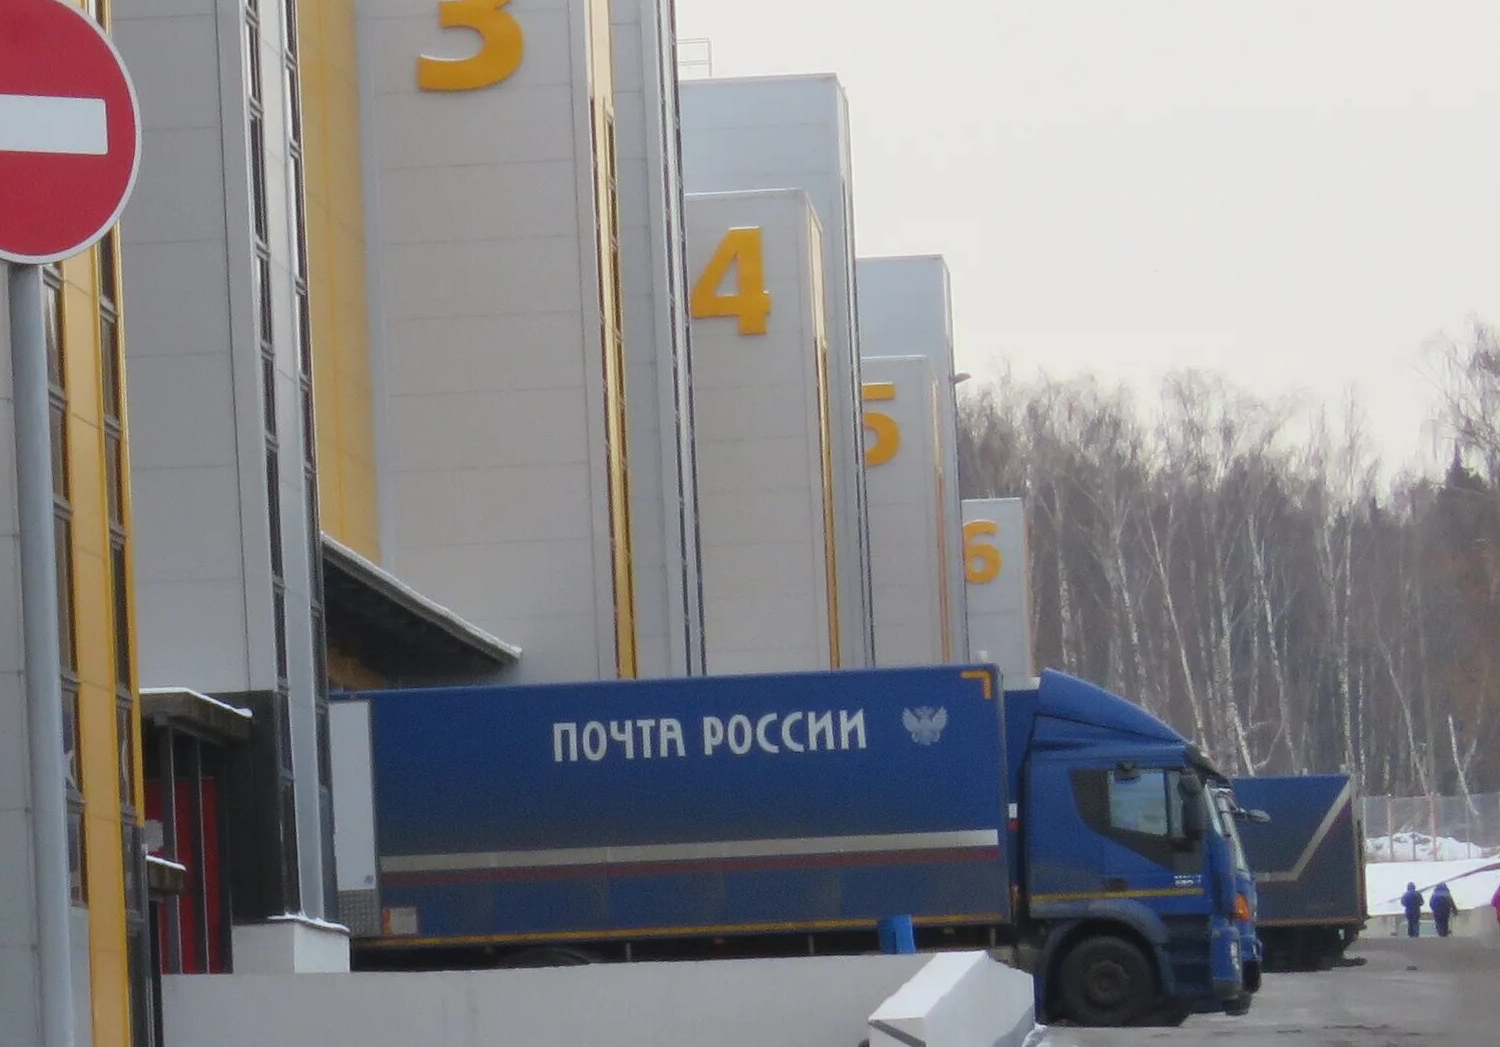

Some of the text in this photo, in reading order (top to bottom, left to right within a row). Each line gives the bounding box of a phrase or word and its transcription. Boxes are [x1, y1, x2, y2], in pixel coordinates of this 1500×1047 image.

[690, 226, 772, 335] 4
[861, 382, 900, 467] 5
[963, 518, 1000, 584] 6
[553, 707, 867, 762] ПОЧТА РОССИИ
